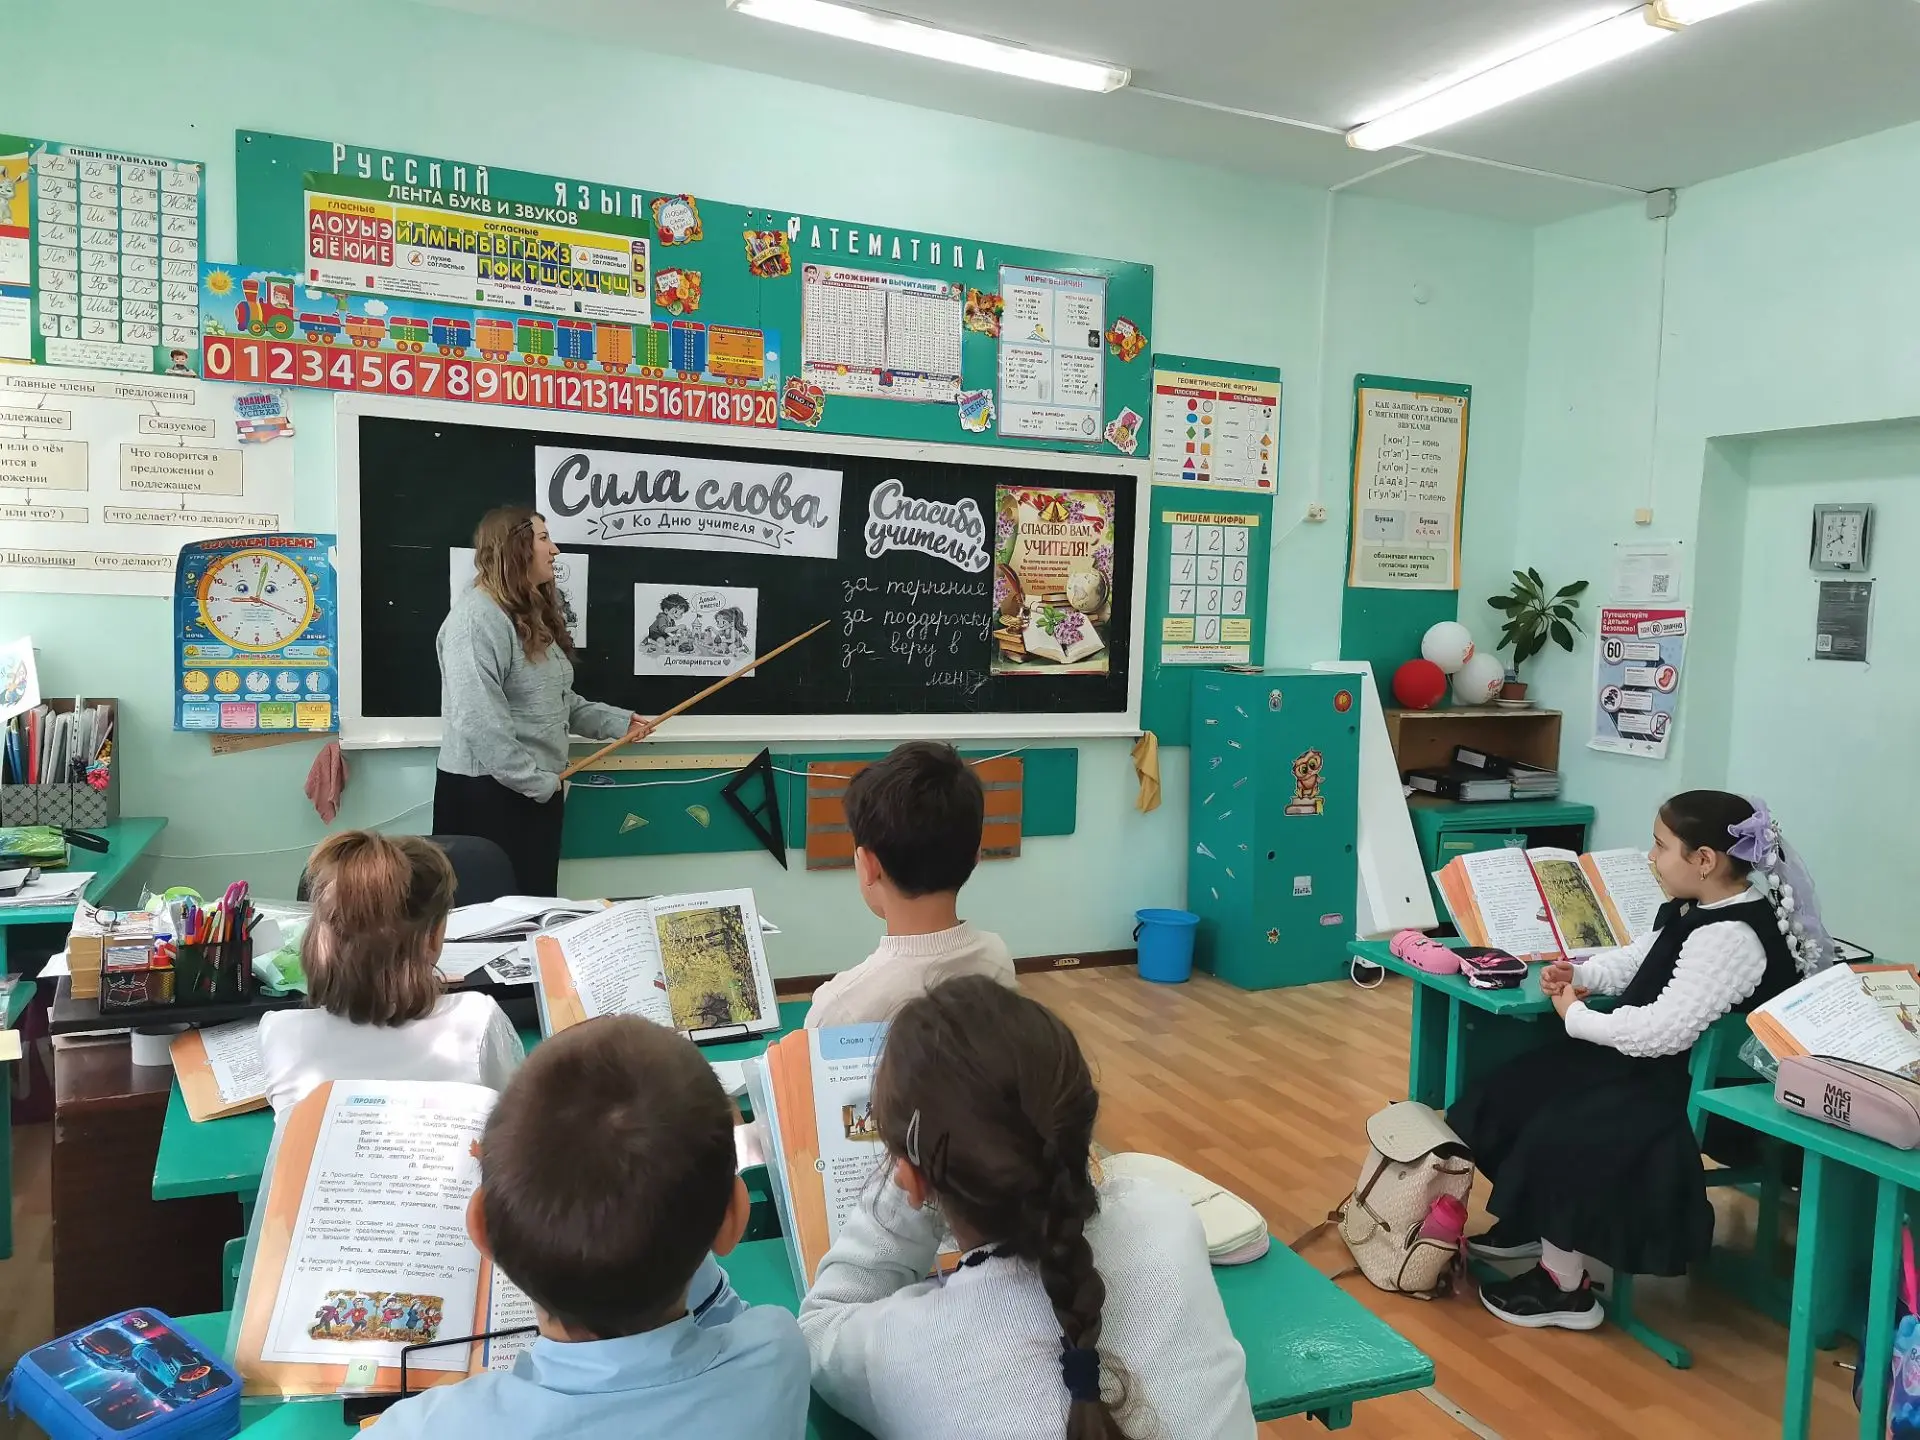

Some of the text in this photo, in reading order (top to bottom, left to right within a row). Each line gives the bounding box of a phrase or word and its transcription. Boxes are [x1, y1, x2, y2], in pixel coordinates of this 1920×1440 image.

[70, 148, 168, 167] ПИШИ ПРАВИЛЬНО
[327, 199, 375, 214] гласные
[387, 184, 578, 226] ЛЕНТА БУКВ И ЗВУКОВ
[484, 222, 539, 237] согласные
[834, 272, 937, 292] СЛОЖЕНИЕ И ВЫЧИТАНИЕ
[1024, 274, 1046, 284] МЕРЫ
[6, 376, 188, 400] Главные члены предложения
[207, 343, 776, 424] 0 1 2 3 4 5 6 7 8 9 10 11 12 13 14 15 16 17 18 19 20
[1177, 377, 1258, 392] ГЕОМЕТРИЧЕСКИЕ ФИГУРЫ
[238, 395, 271, 406] ЗНАНИЯ
[1392, 402, 1429, 412] ЗАПИСАТЬ
[1430, 406, 1453, 414] СЛОВО
[1411, 413, 1458, 424] СОГЛАСНЫМИ
[149, 420, 207, 433] Сказуемое
[7, 444, 29, 452] или
[130, 448, 218, 463] Что говорится в
[130, 464, 204, 477] предложении
[130, 480, 201, 492] подлежащем
[548, 453, 829, 529] Сила слова
[5, 509, 26, 518] или
[134, 511, 177, 522] делает?
[179, 514, 198, 522] что
[200, 515, 246, 526] делают?
[248, 517, 255, 525] и
[1176, 513, 1246, 525] ПИШЕМ ЦИФРЫ
[633, 513, 756, 535] Ко Дню учителя
[1021, 522, 1067, 536] СПАСИБО
[268, 537, 316, 548] ВРЕМЯ
[868, 519, 978, 568] учитель!
[1184, 528, 1246, 552] 1 2 3
[1024, 539, 1089, 557] УЧИТЕЛЯ!
[8, 553, 173, 568] Школьники (что делают?)
[1182, 558, 1244, 581] 4 5 6
[842, 575, 988, 606] за терпение
[1179, 589, 1243, 611] 7 8 9
[1603, 611, 1649, 619] Путешествуйте
[842, 607, 992, 641] за поддержку
[1204, 618, 1216, 640] 0
[842, 632, 959, 669] за веру в
[1607, 641, 1621, 658] 60
[664, 656, 722, 667] Договариваться
[1825, 1083, 1851, 1101] MAG
[1824, 1092, 1851, 1113] NIFI
[1823, 1104, 1850, 1123] QUE
[358, 1363, 368, 1373] 40
